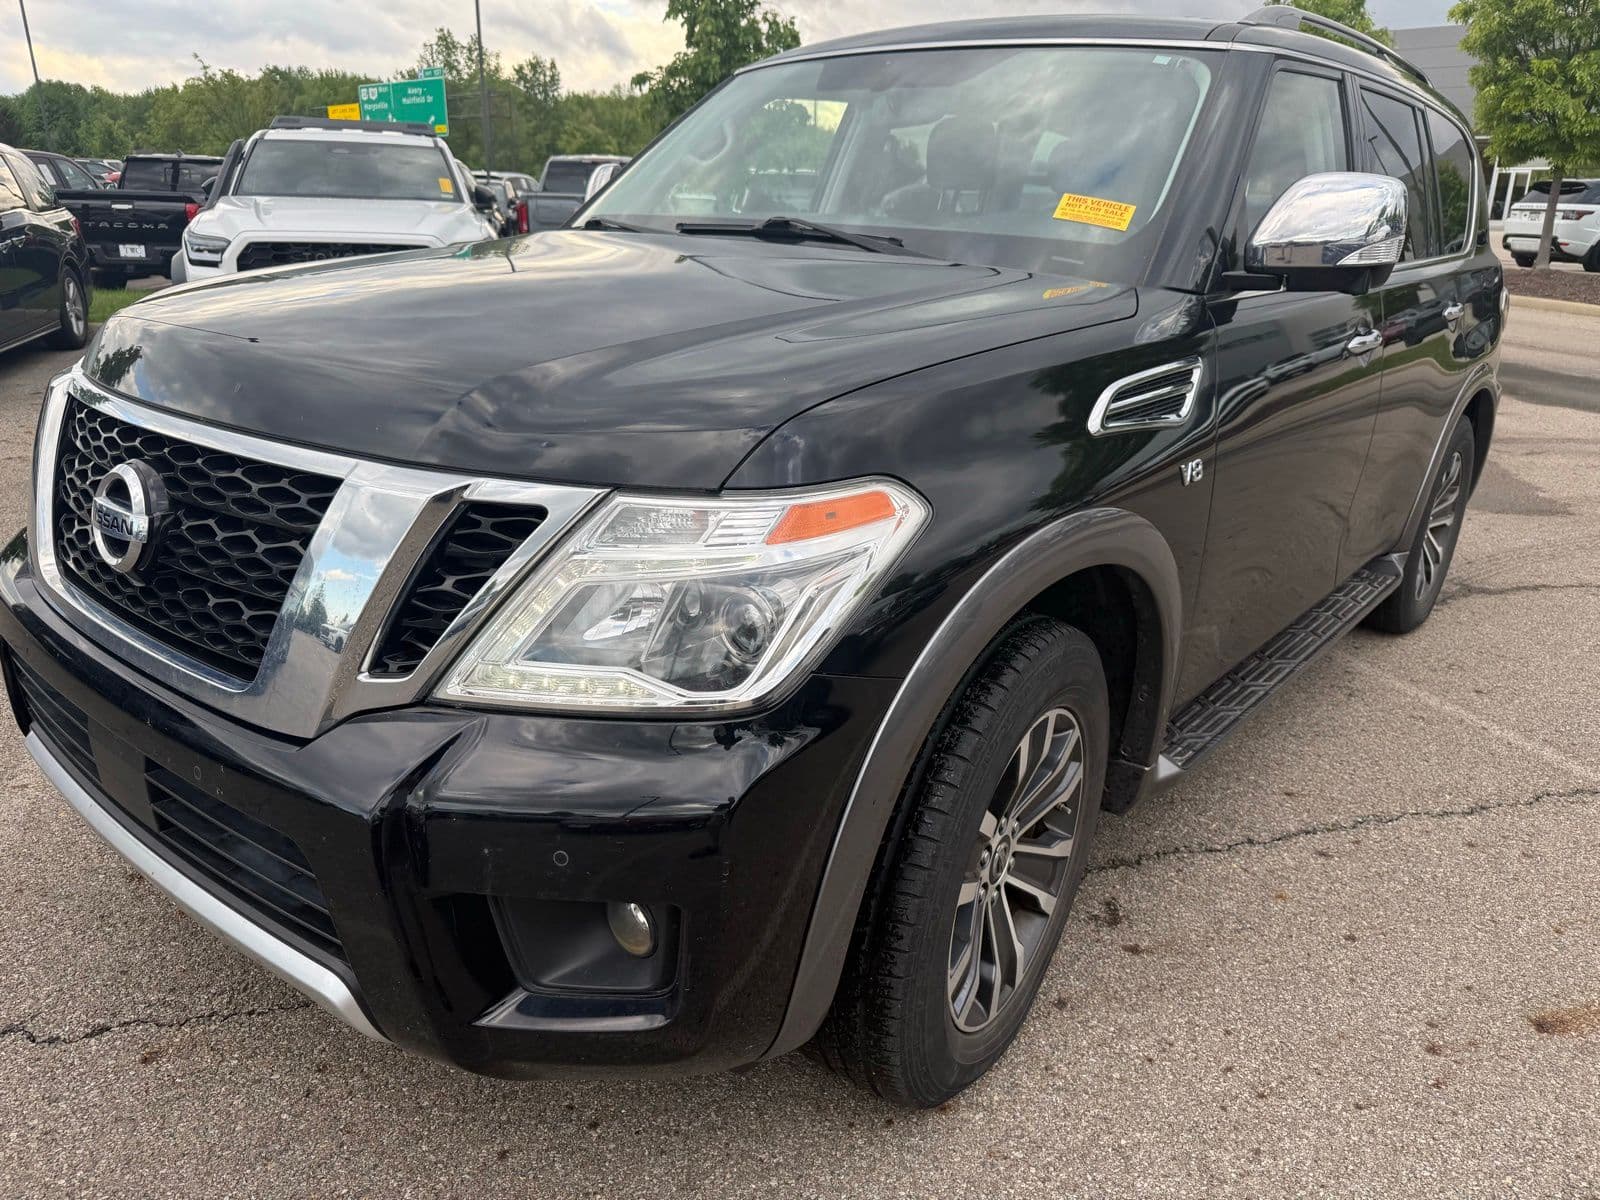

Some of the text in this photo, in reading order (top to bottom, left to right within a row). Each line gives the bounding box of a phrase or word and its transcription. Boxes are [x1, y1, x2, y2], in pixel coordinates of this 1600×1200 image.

[1067, 195, 1129, 213] THIS VEHICLE
[1084, 205, 1101, 213] FOR
[1103, 208, 1126, 217] SALE
[84, 221, 169, 230] TACOMA
[1180, 458, 1203, 487] V8
